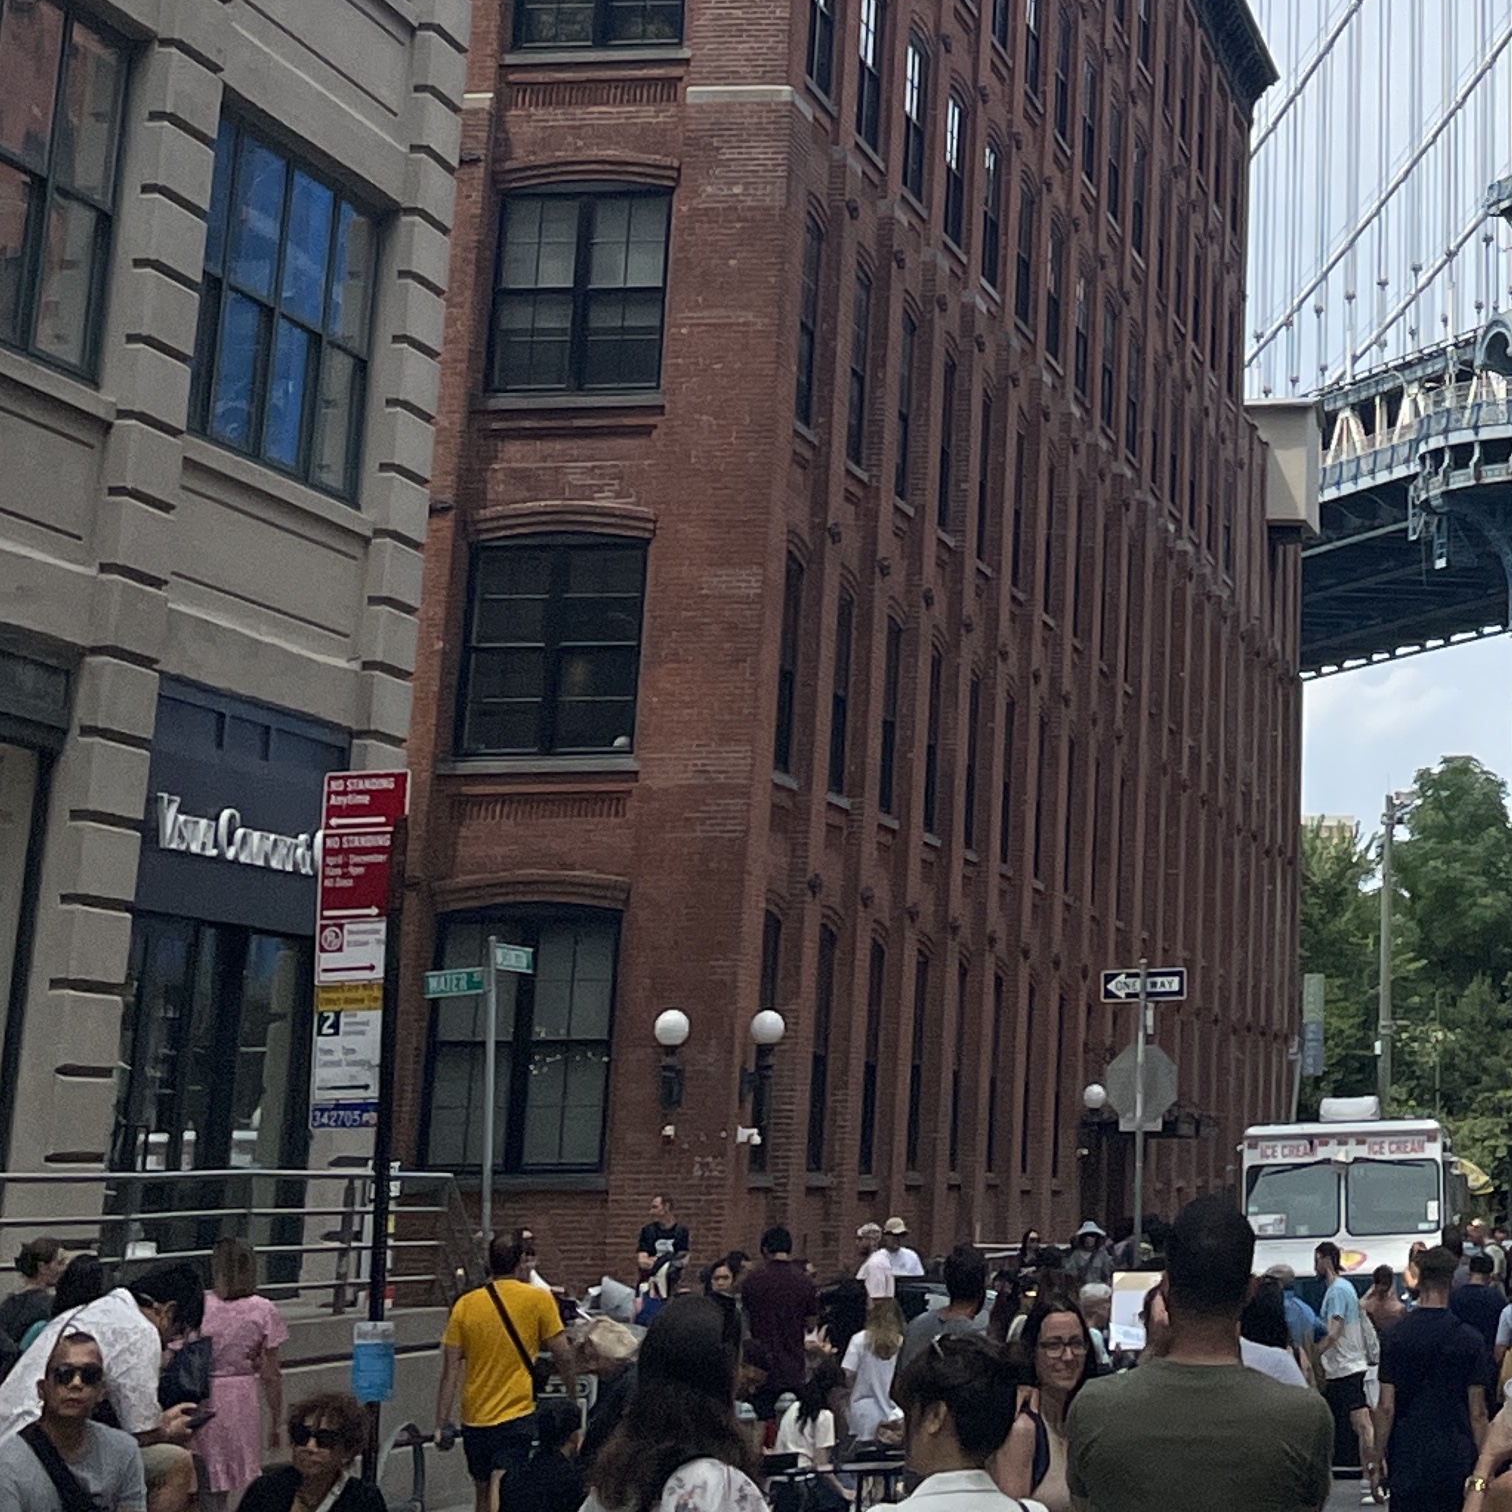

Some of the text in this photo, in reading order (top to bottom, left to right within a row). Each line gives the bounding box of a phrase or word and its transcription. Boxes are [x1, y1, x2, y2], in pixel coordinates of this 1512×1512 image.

[329, 777, 395, 791] NO STANDING
[325, 834, 391, 849] NO STANDING
[428, 973, 468, 993] WATER
[1115, 979, 1175, 992] ONE WAY
[321, 1011, 337, 1035] 2
[1260, 1142, 1317, 1160] ICE CREAM
[1367, 1139, 1425, 1156] ICE CREAM
